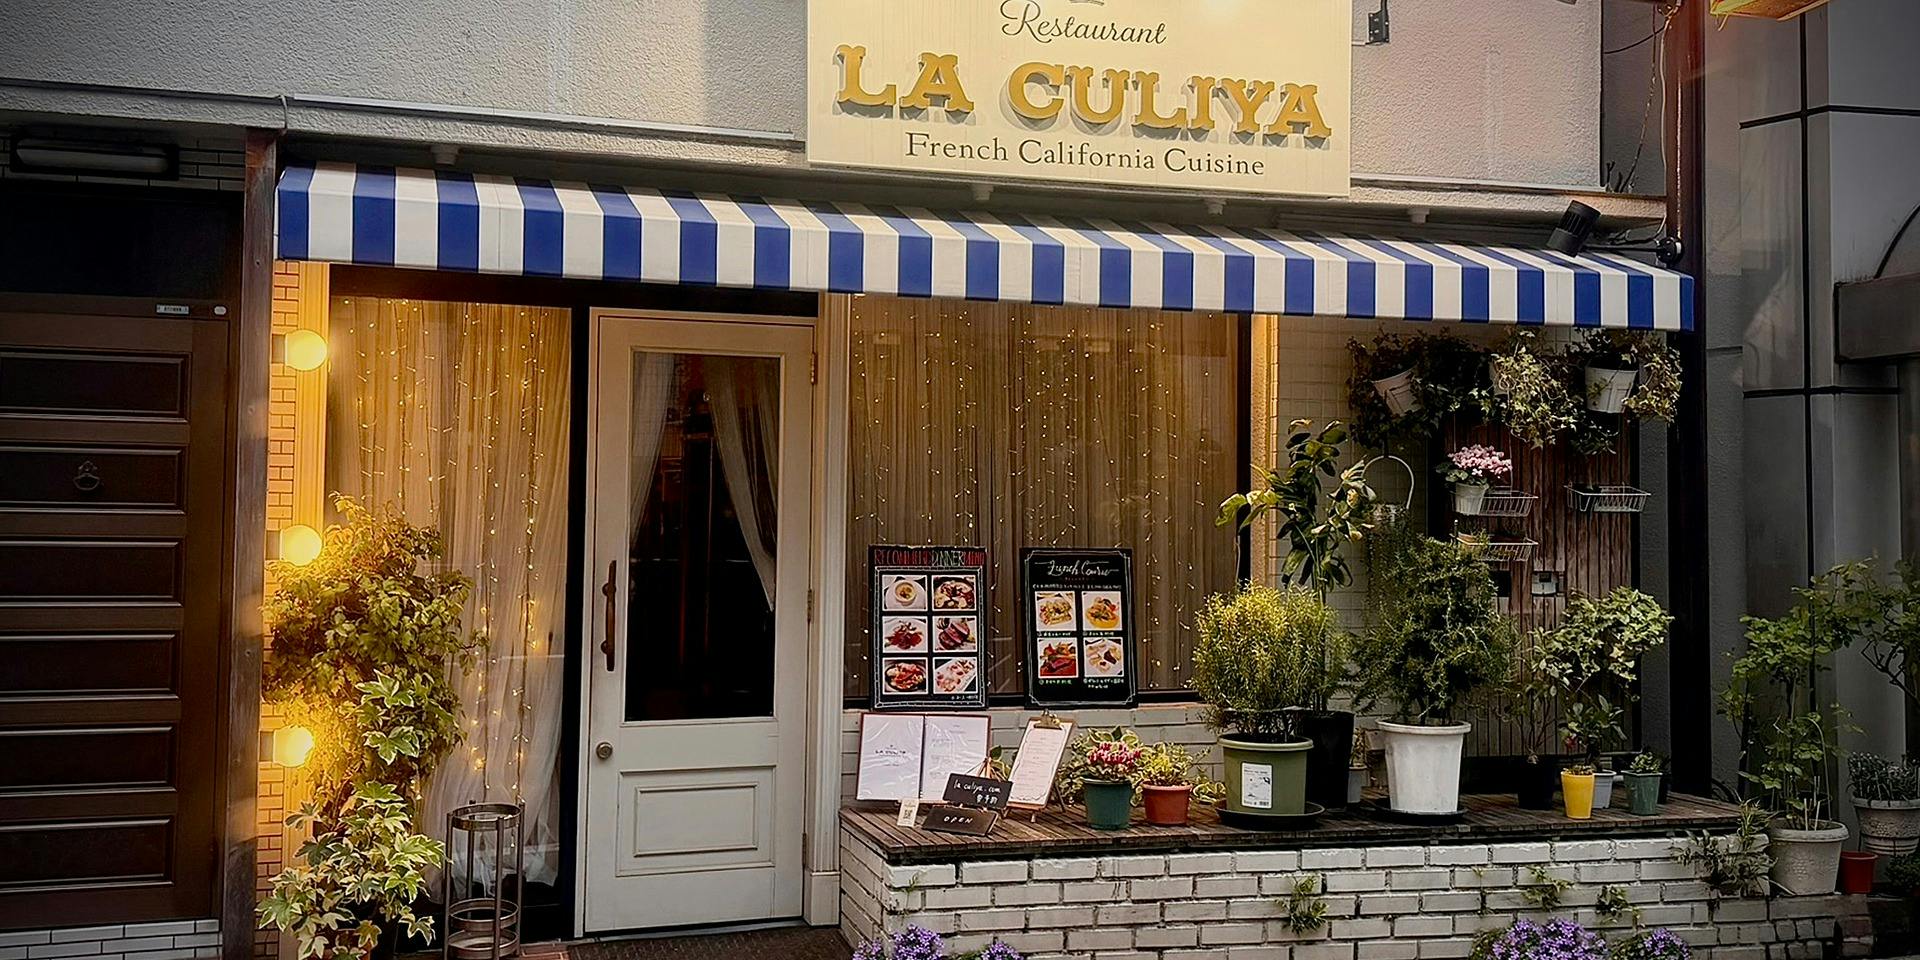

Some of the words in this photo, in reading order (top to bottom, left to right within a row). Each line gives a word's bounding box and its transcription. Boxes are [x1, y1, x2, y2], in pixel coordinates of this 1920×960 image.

[1000, 0, 1168, 45] Restaurant
[836, 44, 975, 114] LA
[1007, 61, 1332, 138] CULIYA
[905, 132, 1009, 161] French
[1018, 139, 1156, 170] California
[1163, 147, 1265, 175] Cuisine
[1046, 559, 1080, 577] Lunch
[943, 815, 973, 824] OPEN
